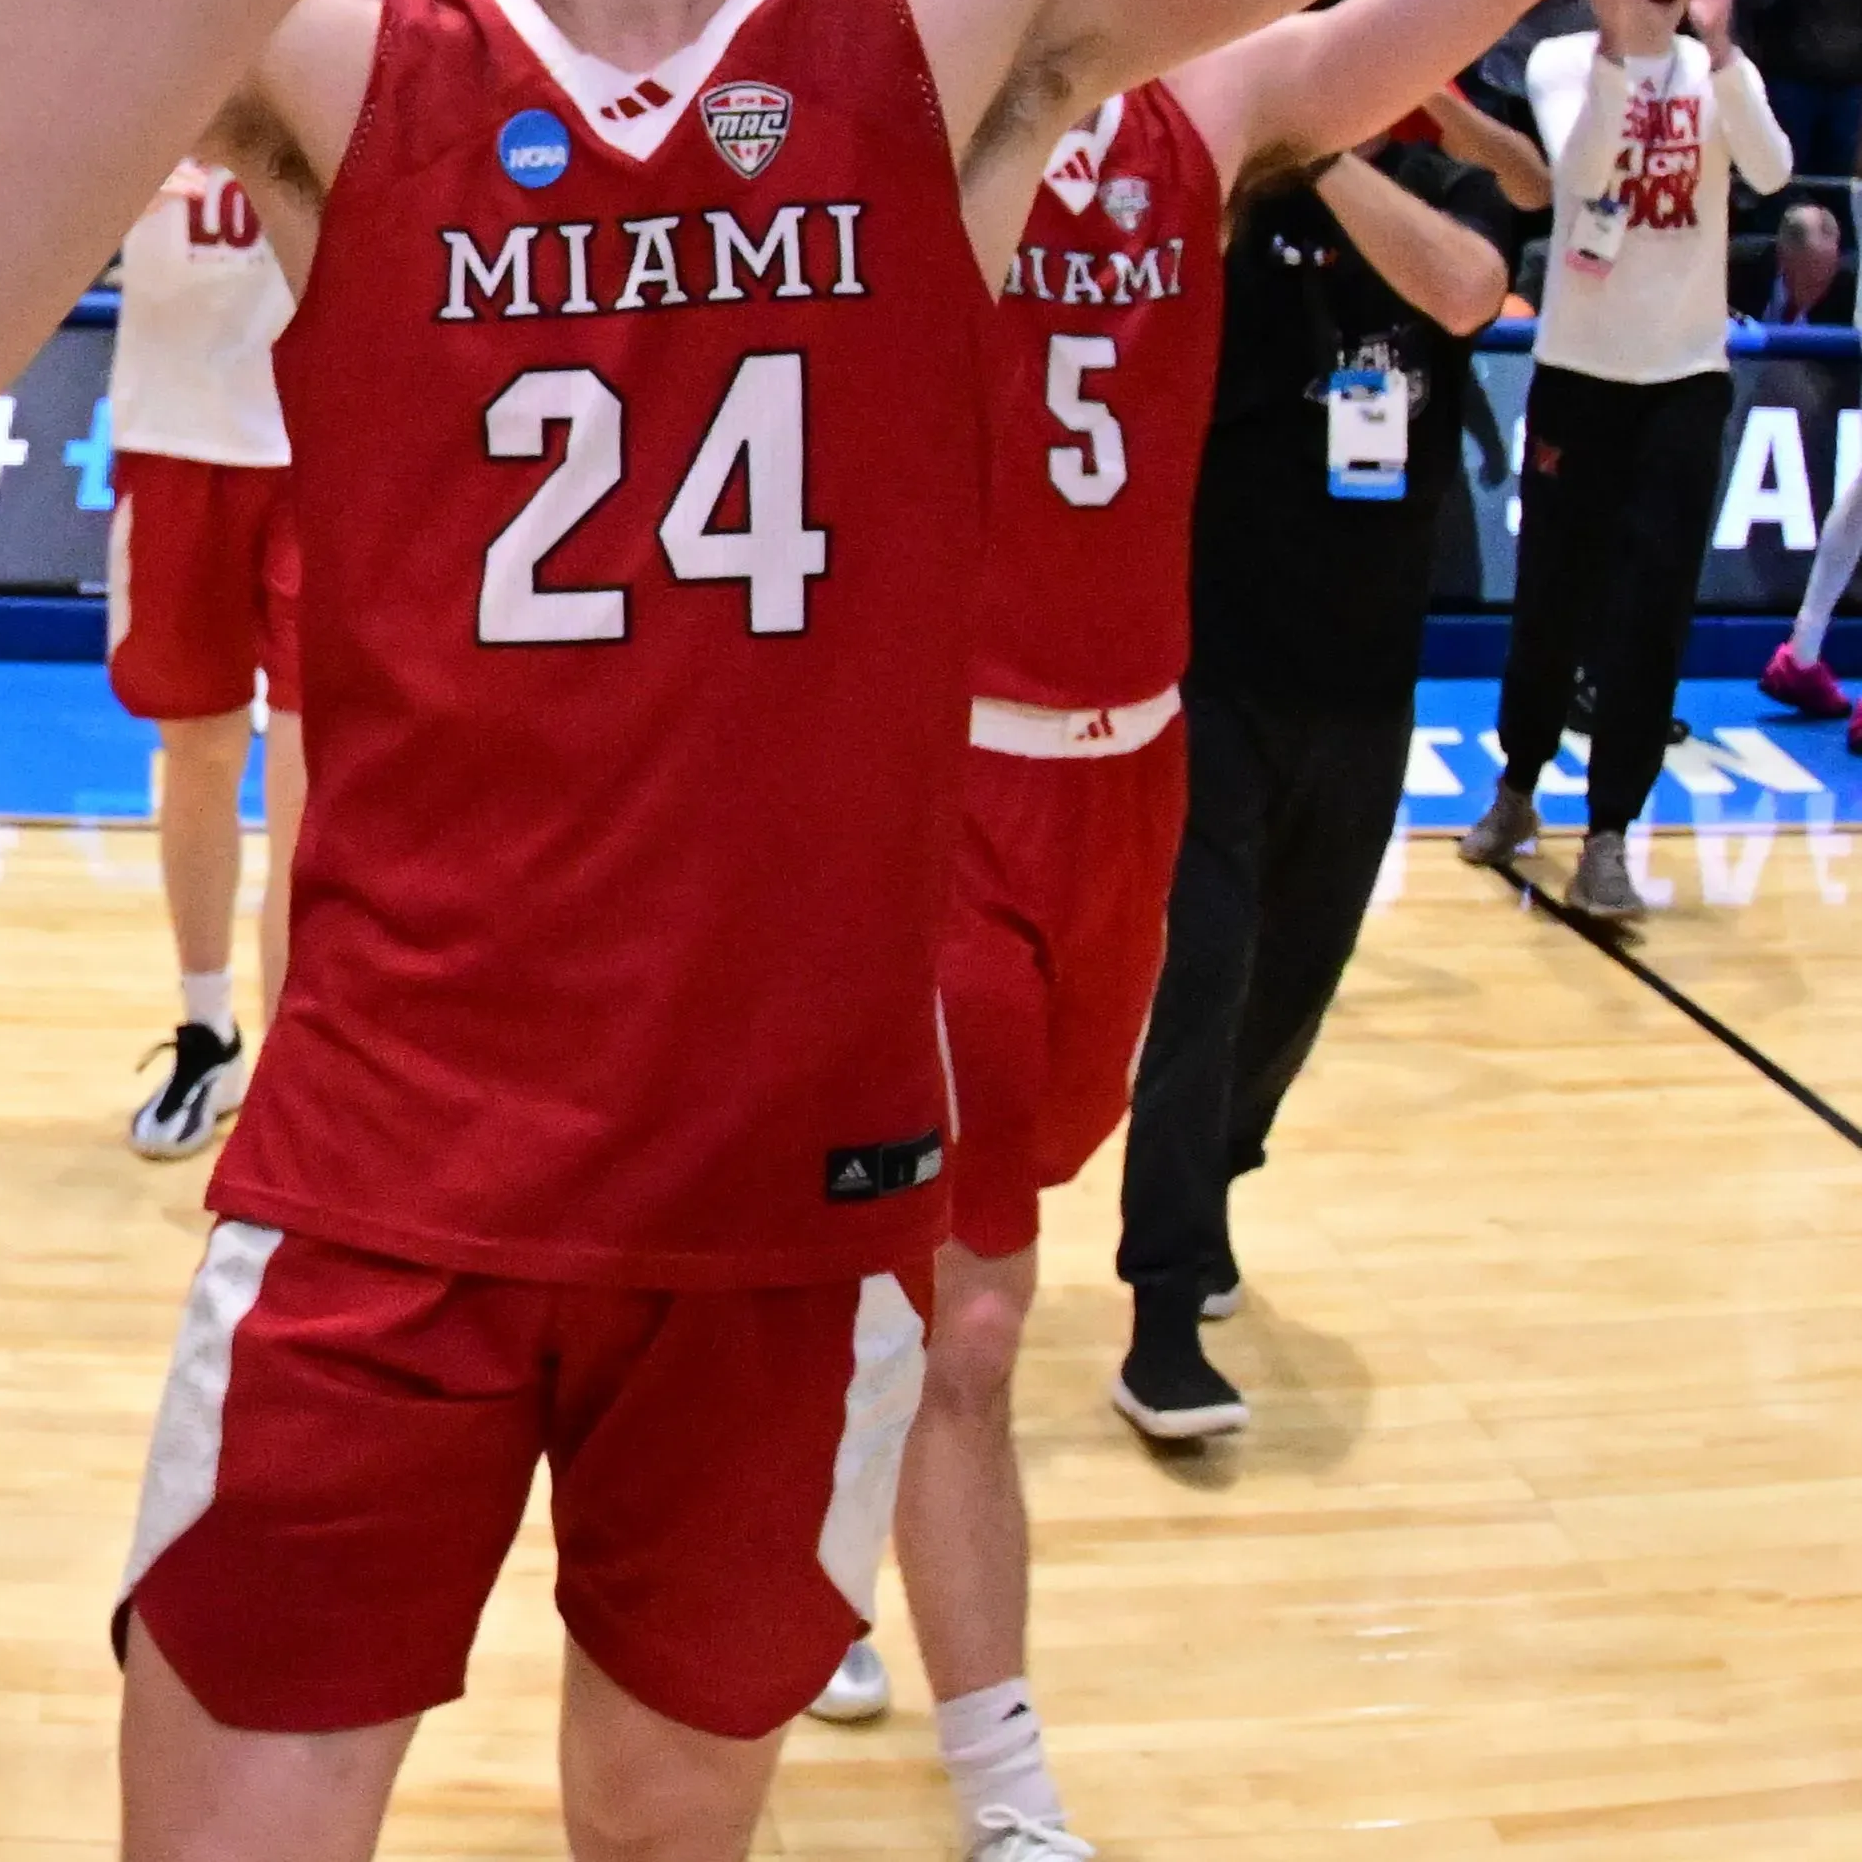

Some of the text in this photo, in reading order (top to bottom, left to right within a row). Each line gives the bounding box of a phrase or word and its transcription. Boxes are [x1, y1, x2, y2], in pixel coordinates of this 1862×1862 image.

[708, 111, 786, 139] MAC
[437, 203, 867, 321] MIAMI
[1045, 334, 1129, 508] 5
[476, 351, 828, 644] 24
